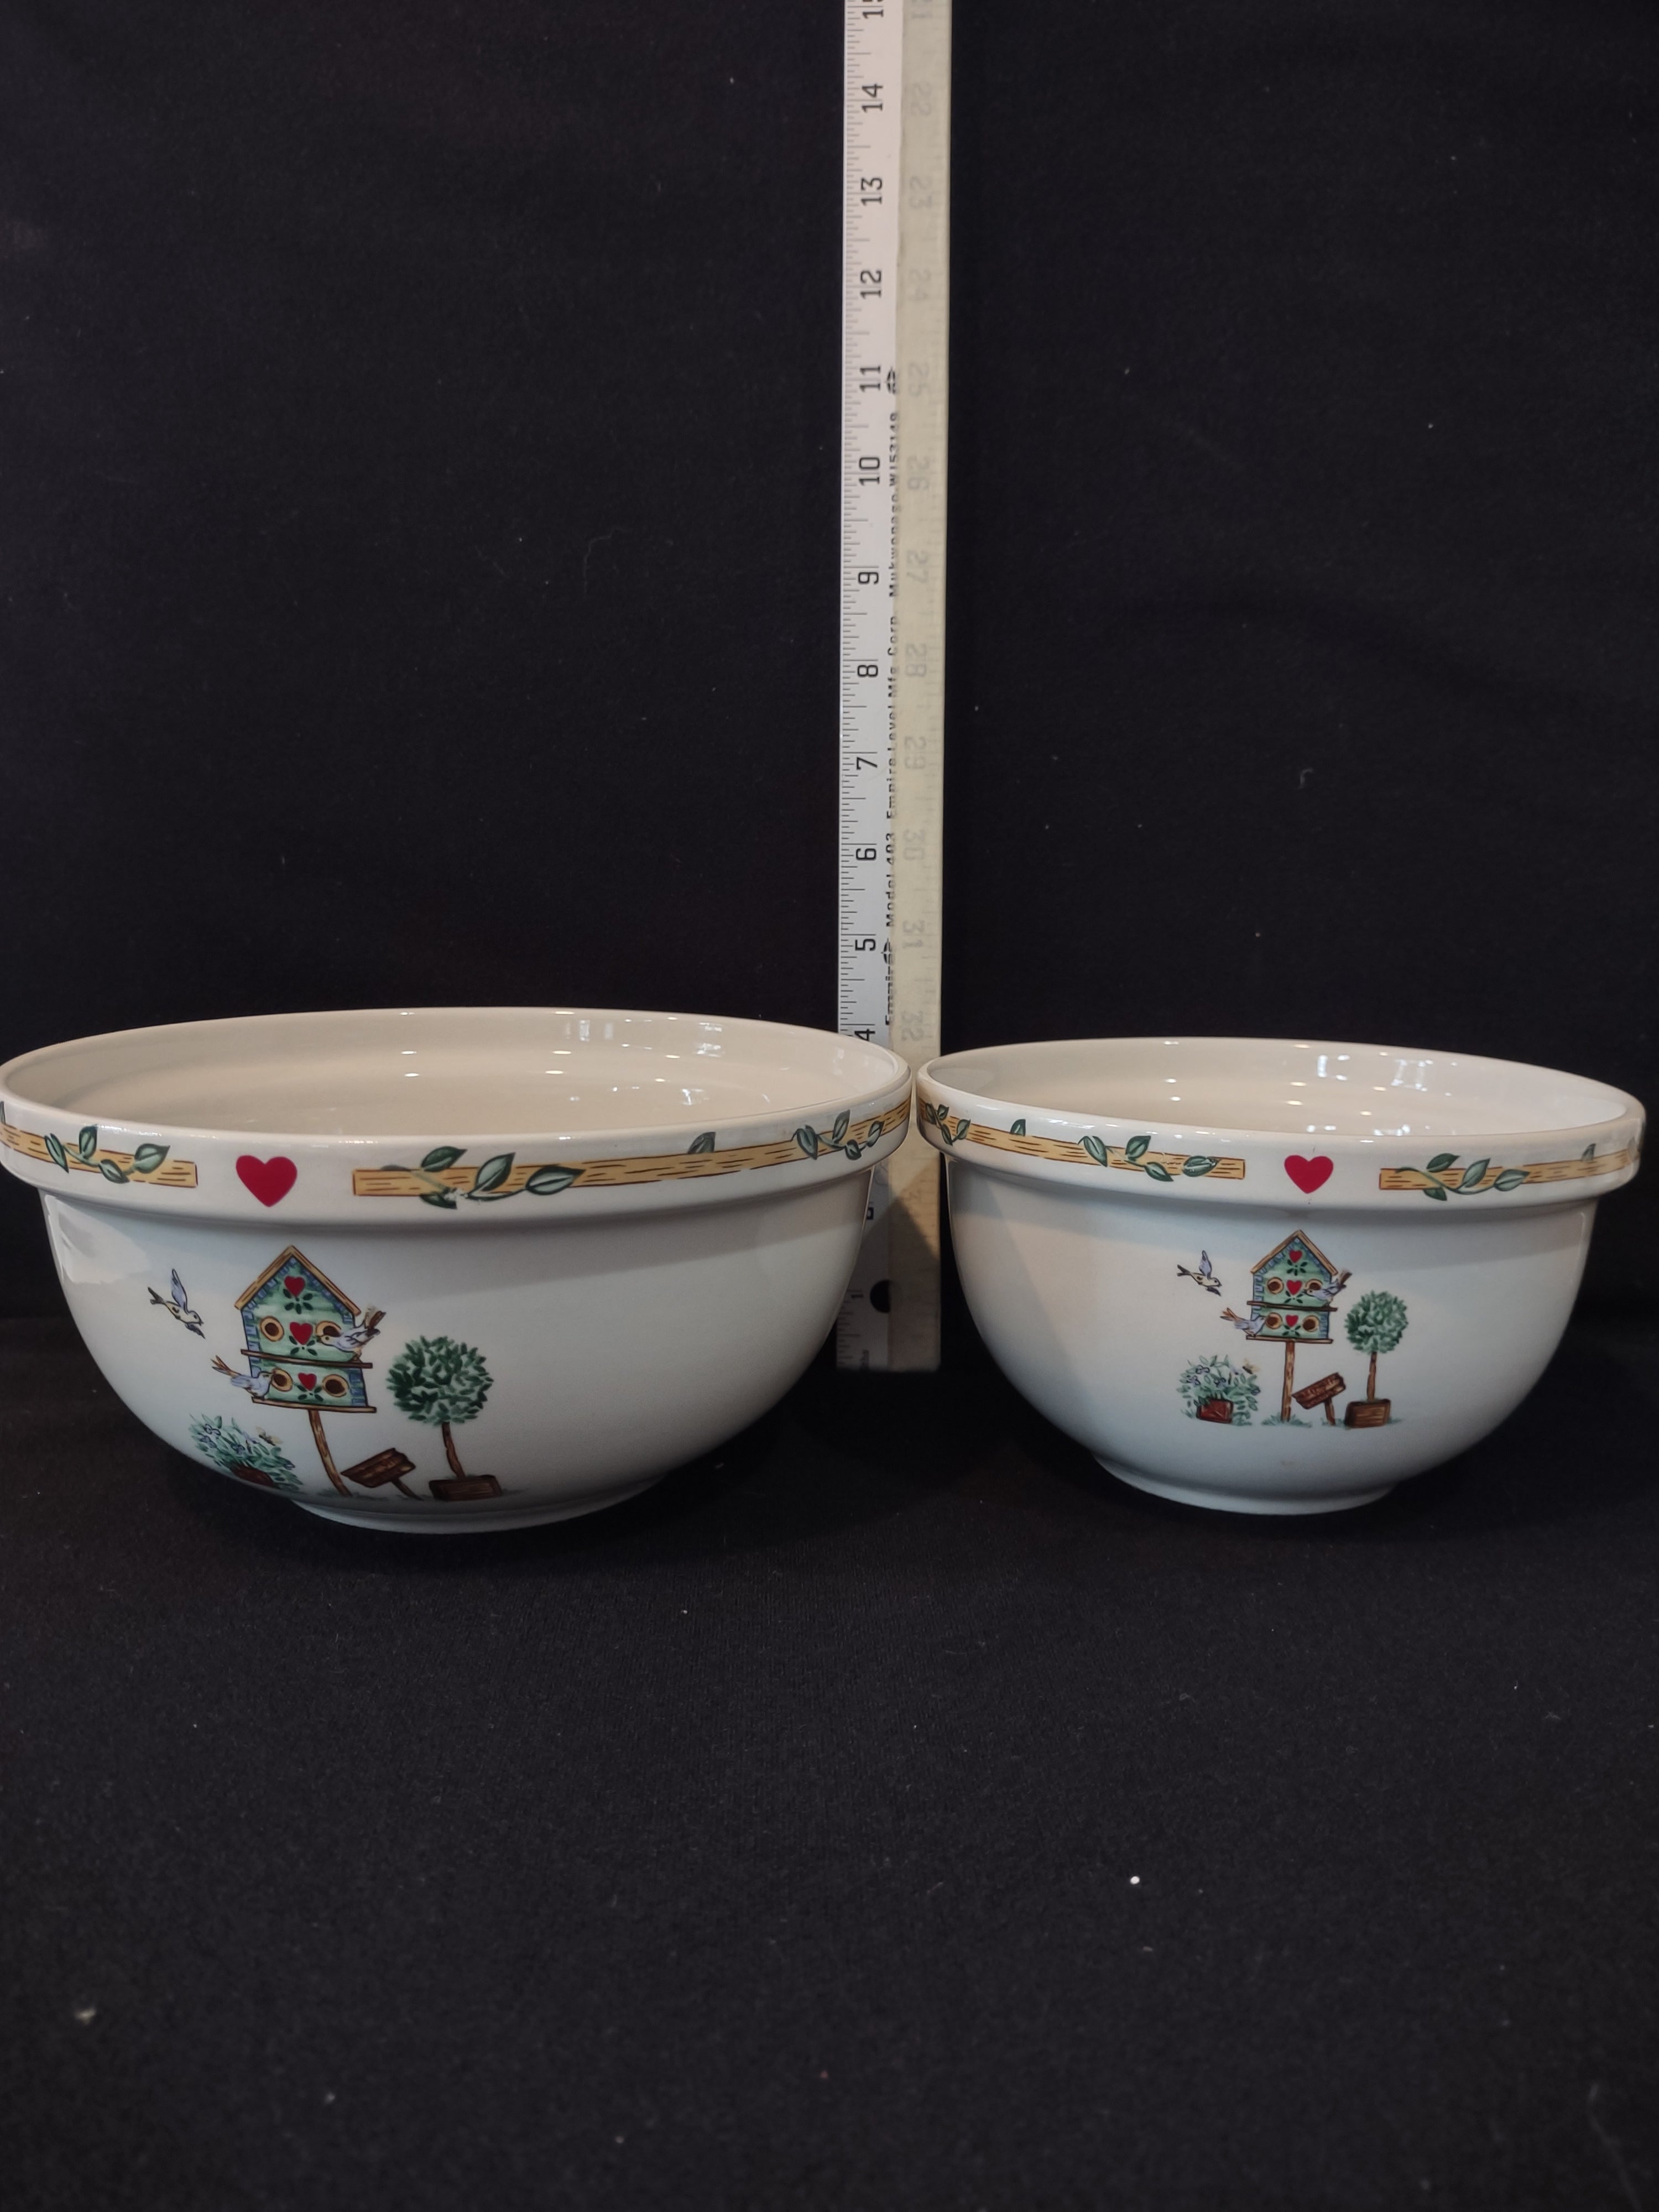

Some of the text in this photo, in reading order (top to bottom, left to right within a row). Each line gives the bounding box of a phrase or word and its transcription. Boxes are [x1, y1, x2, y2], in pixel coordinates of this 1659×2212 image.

[862, 0, 884, 19] 1
[862, 83, 883, 113] 14
[860, 177, 883, 206] 13
[860, 270, 882, 299] 12
[859, 365, 881, 393] 11
[858, 456, 880, 486] 10
[857, 571, 879, 585] 9
[857, 664, 879, 679] 8
[855, 757, 878, 770] 7
[855, 848, 877, 861] 6
[854, 938, 877, 952] 5
[854, 1027, 876, 1042] 4
